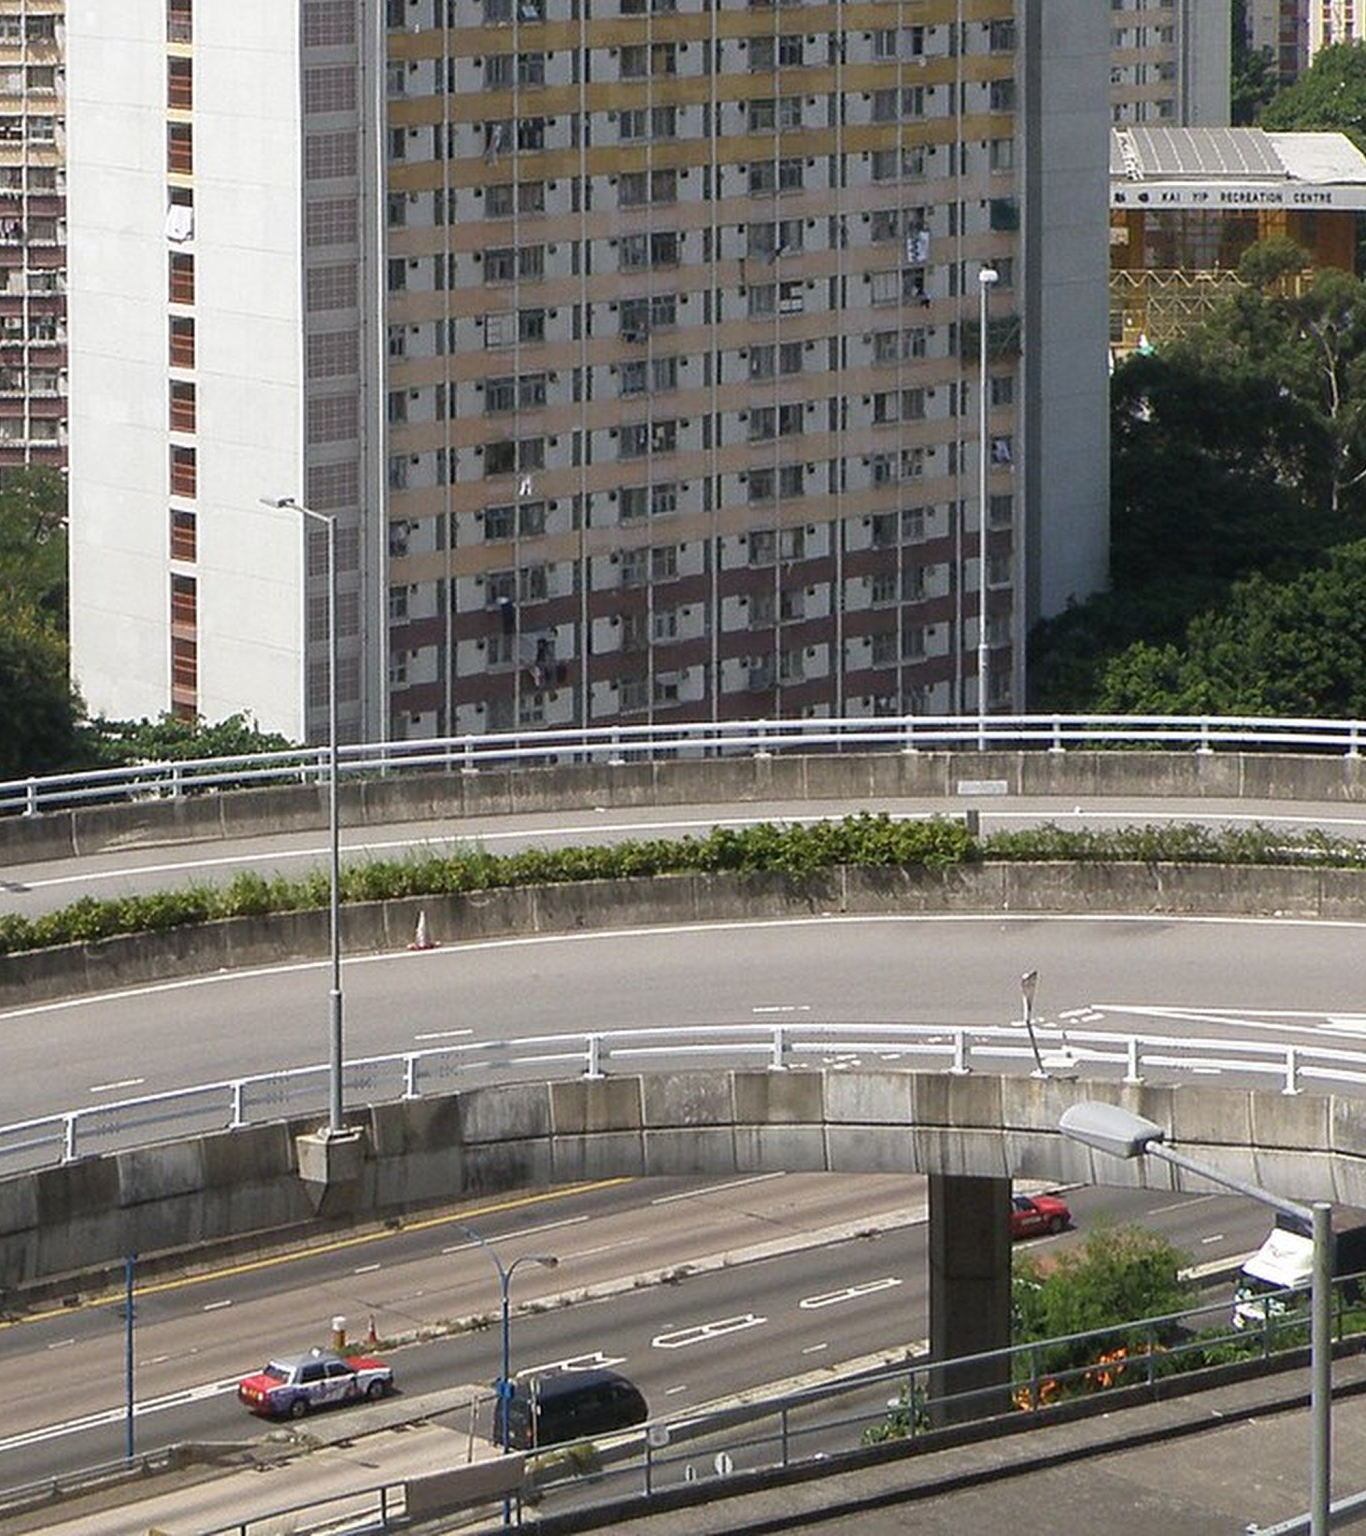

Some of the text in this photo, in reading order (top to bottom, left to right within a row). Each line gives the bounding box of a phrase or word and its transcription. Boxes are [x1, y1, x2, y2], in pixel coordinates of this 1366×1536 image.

[1161, 192, 1181, 203] KAI
[1192, 192, 1209, 203] YIP
[1220, 192, 1283, 203] RECREATION
[1293, 192, 1333, 204] CENTRE
